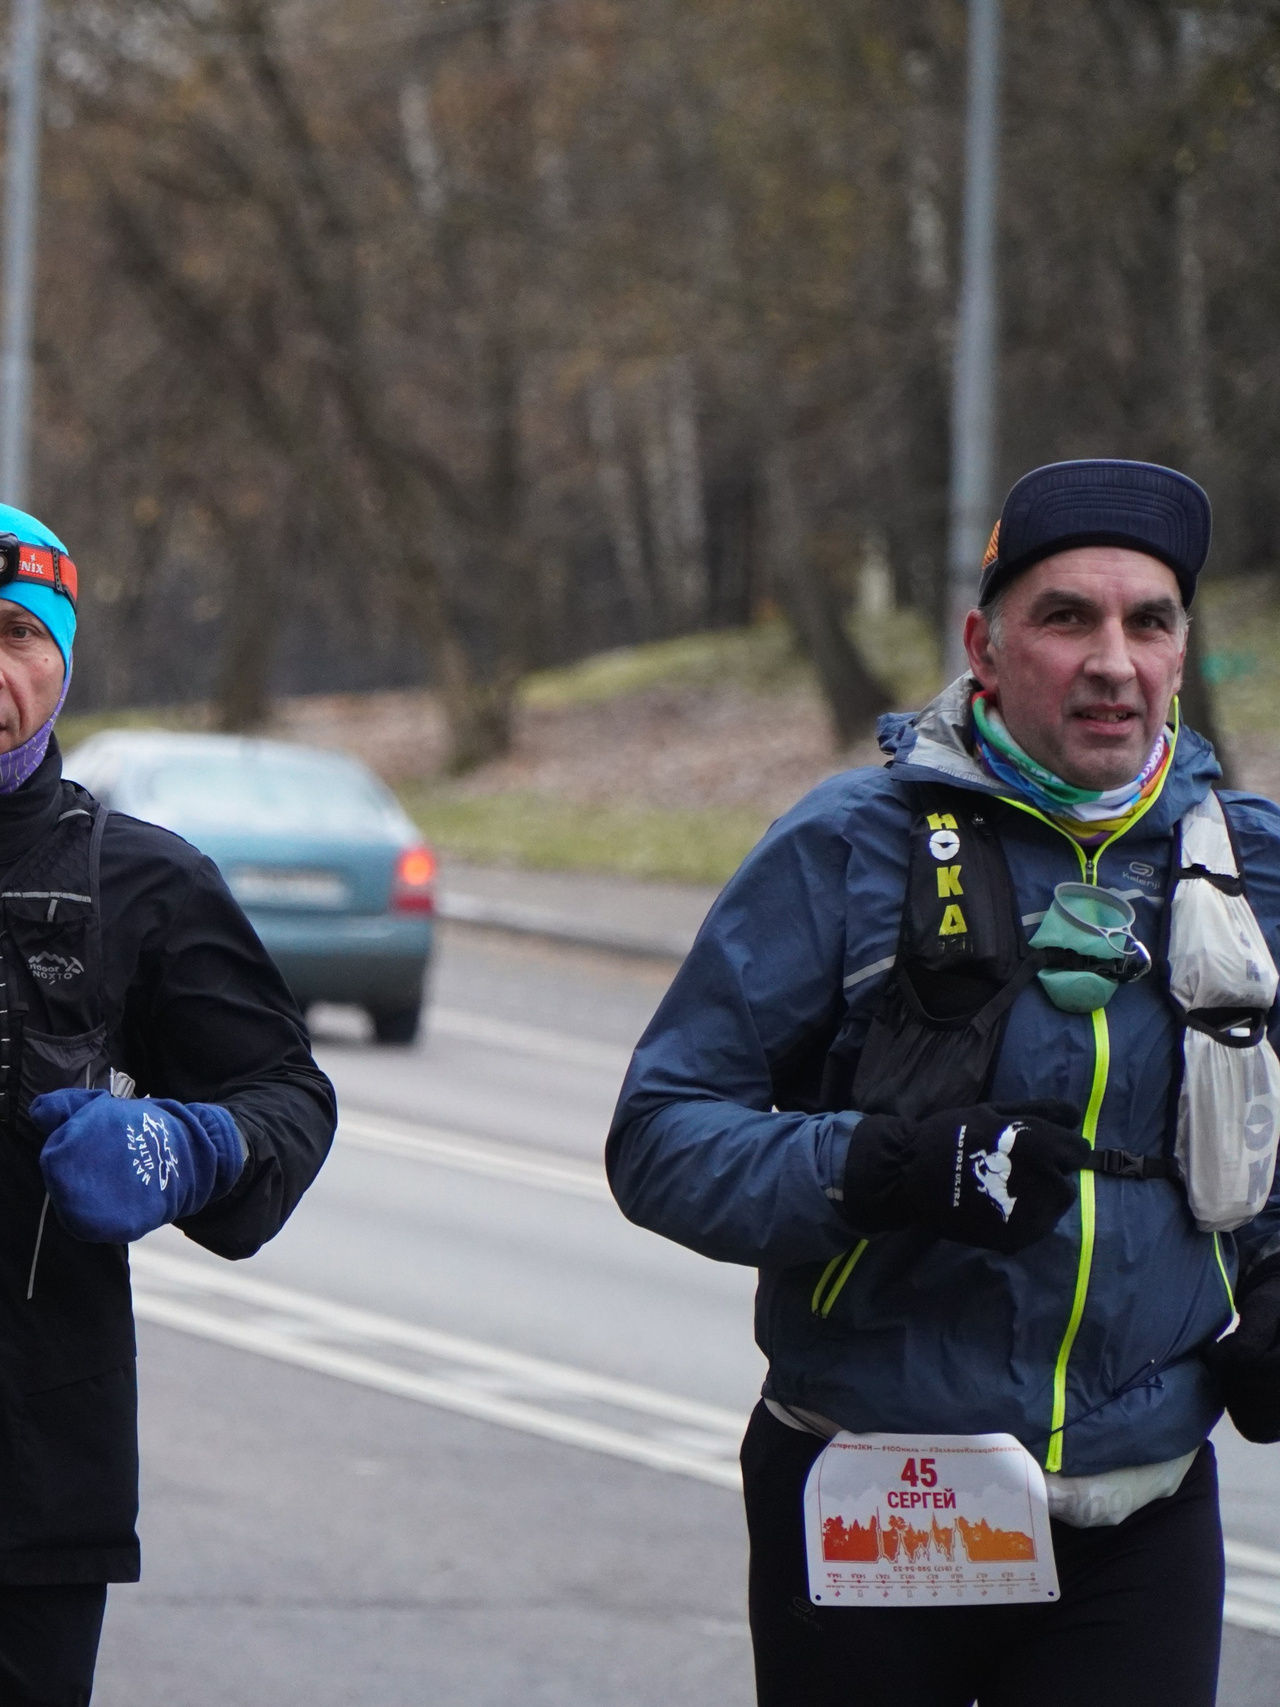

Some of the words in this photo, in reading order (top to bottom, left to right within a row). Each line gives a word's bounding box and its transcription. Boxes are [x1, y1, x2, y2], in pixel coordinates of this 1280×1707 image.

[926, 812, 968, 936] HOKA
[1122, 871, 1161, 890] Kalenji
[126, 1124, 136, 1151] FOX
[957, 1124, 968, 1148] MAD
[134, 1133, 155, 1170] ULTRA
[954, 1148, 964, 1172] FOX
[132, 1157, 151, 1186] MAD
[952, 1172, 963, 1208] ULTRA
[900, 1457, 938, 1488] 45
[887, 1488, 957, 1509] СЕРГЕЙ
